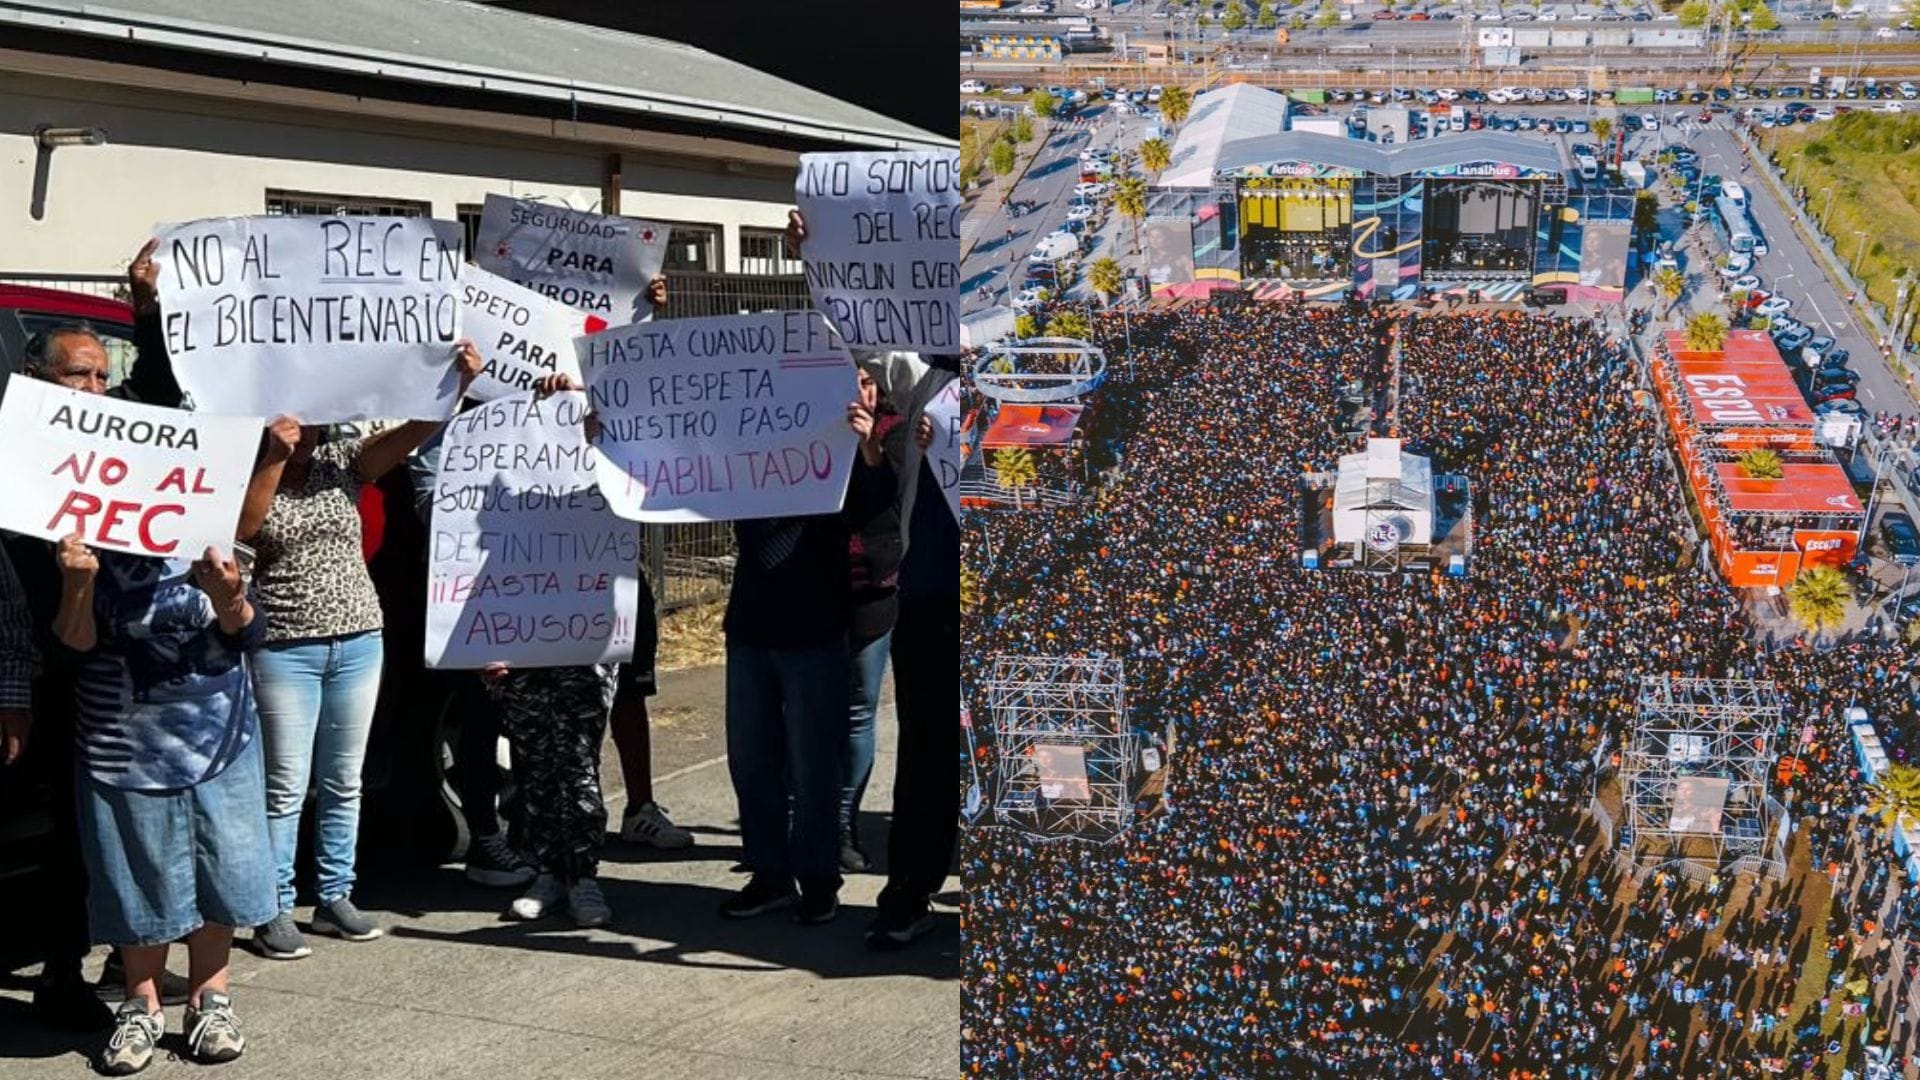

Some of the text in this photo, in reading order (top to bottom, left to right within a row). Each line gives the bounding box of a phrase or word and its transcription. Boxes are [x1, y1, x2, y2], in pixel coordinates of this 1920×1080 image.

[806, 161, 849, 197] NO
[1271, 163, 1312, 175] Antuco
[1456, 164, 1511, 176] Lanalhue
[509, 208, 616, 239] SEGURIDAD
[853, 212, 901, 244] DEL
[172, 222, 462, 289] NO AL REC EN
[547, 248, 615, 275] PARA
[805, 260, 894, 289] NINGUN
[463, 285, 530, 326] SPETO
[167, 312, 196, 355] EL
[589, 333, 676, 366] HASTA
[688, 324, 775, 357] CUANDO
[497, 332, 558, 372] PARA
[589, 369, 775, 408] NO RESPETA
[49, 404, 199, 450] AURORA
[451, 400, 543, 434] HASTA
[600, 402, 810, 443] NUESTRO PASO
[51, 451, 215, 494] NO AL
[625, 440, 832, 497] HABILITADO
[439, 482, 606, 513] SOLUCIONES
[46, 490, 185, 553] REC
[1370, 529, 1396, 541] REC
[434, 530, 638, 564] DEFINITIVAS
[577, 573, 610, 592] DE
